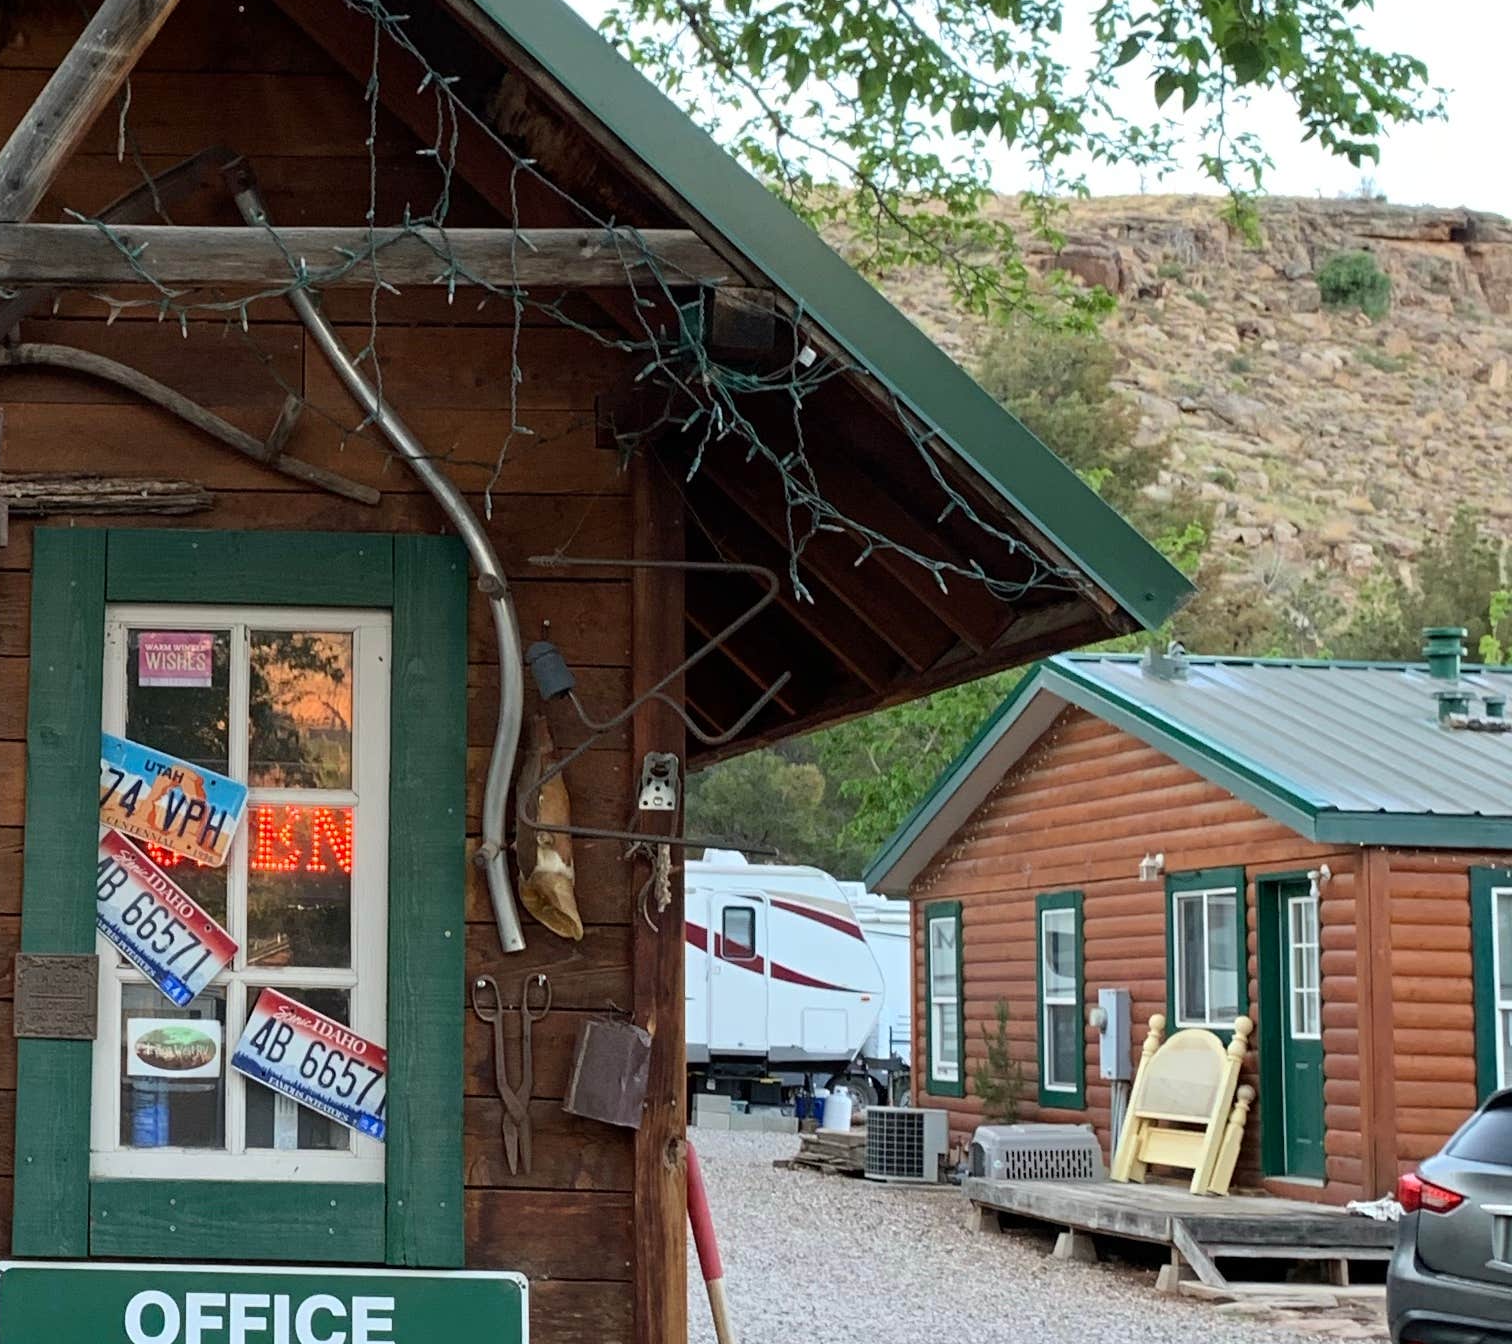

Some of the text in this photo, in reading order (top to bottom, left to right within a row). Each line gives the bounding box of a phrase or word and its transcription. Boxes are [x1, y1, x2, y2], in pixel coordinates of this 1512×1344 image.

[145, 652, 206, 672] WISHES
[144, 759, 185, 784] UTAH
[99, 767, 228, 851] 74 VPH
[106, 816, 175, 848] CENTENNIAL
[147, 873, 195, 919] IDAHO
[121, 891, 212, 982] 66571
[249, 1017, 295, 1063] 4B
[311, 1019, 367, 1055] IDAHO
